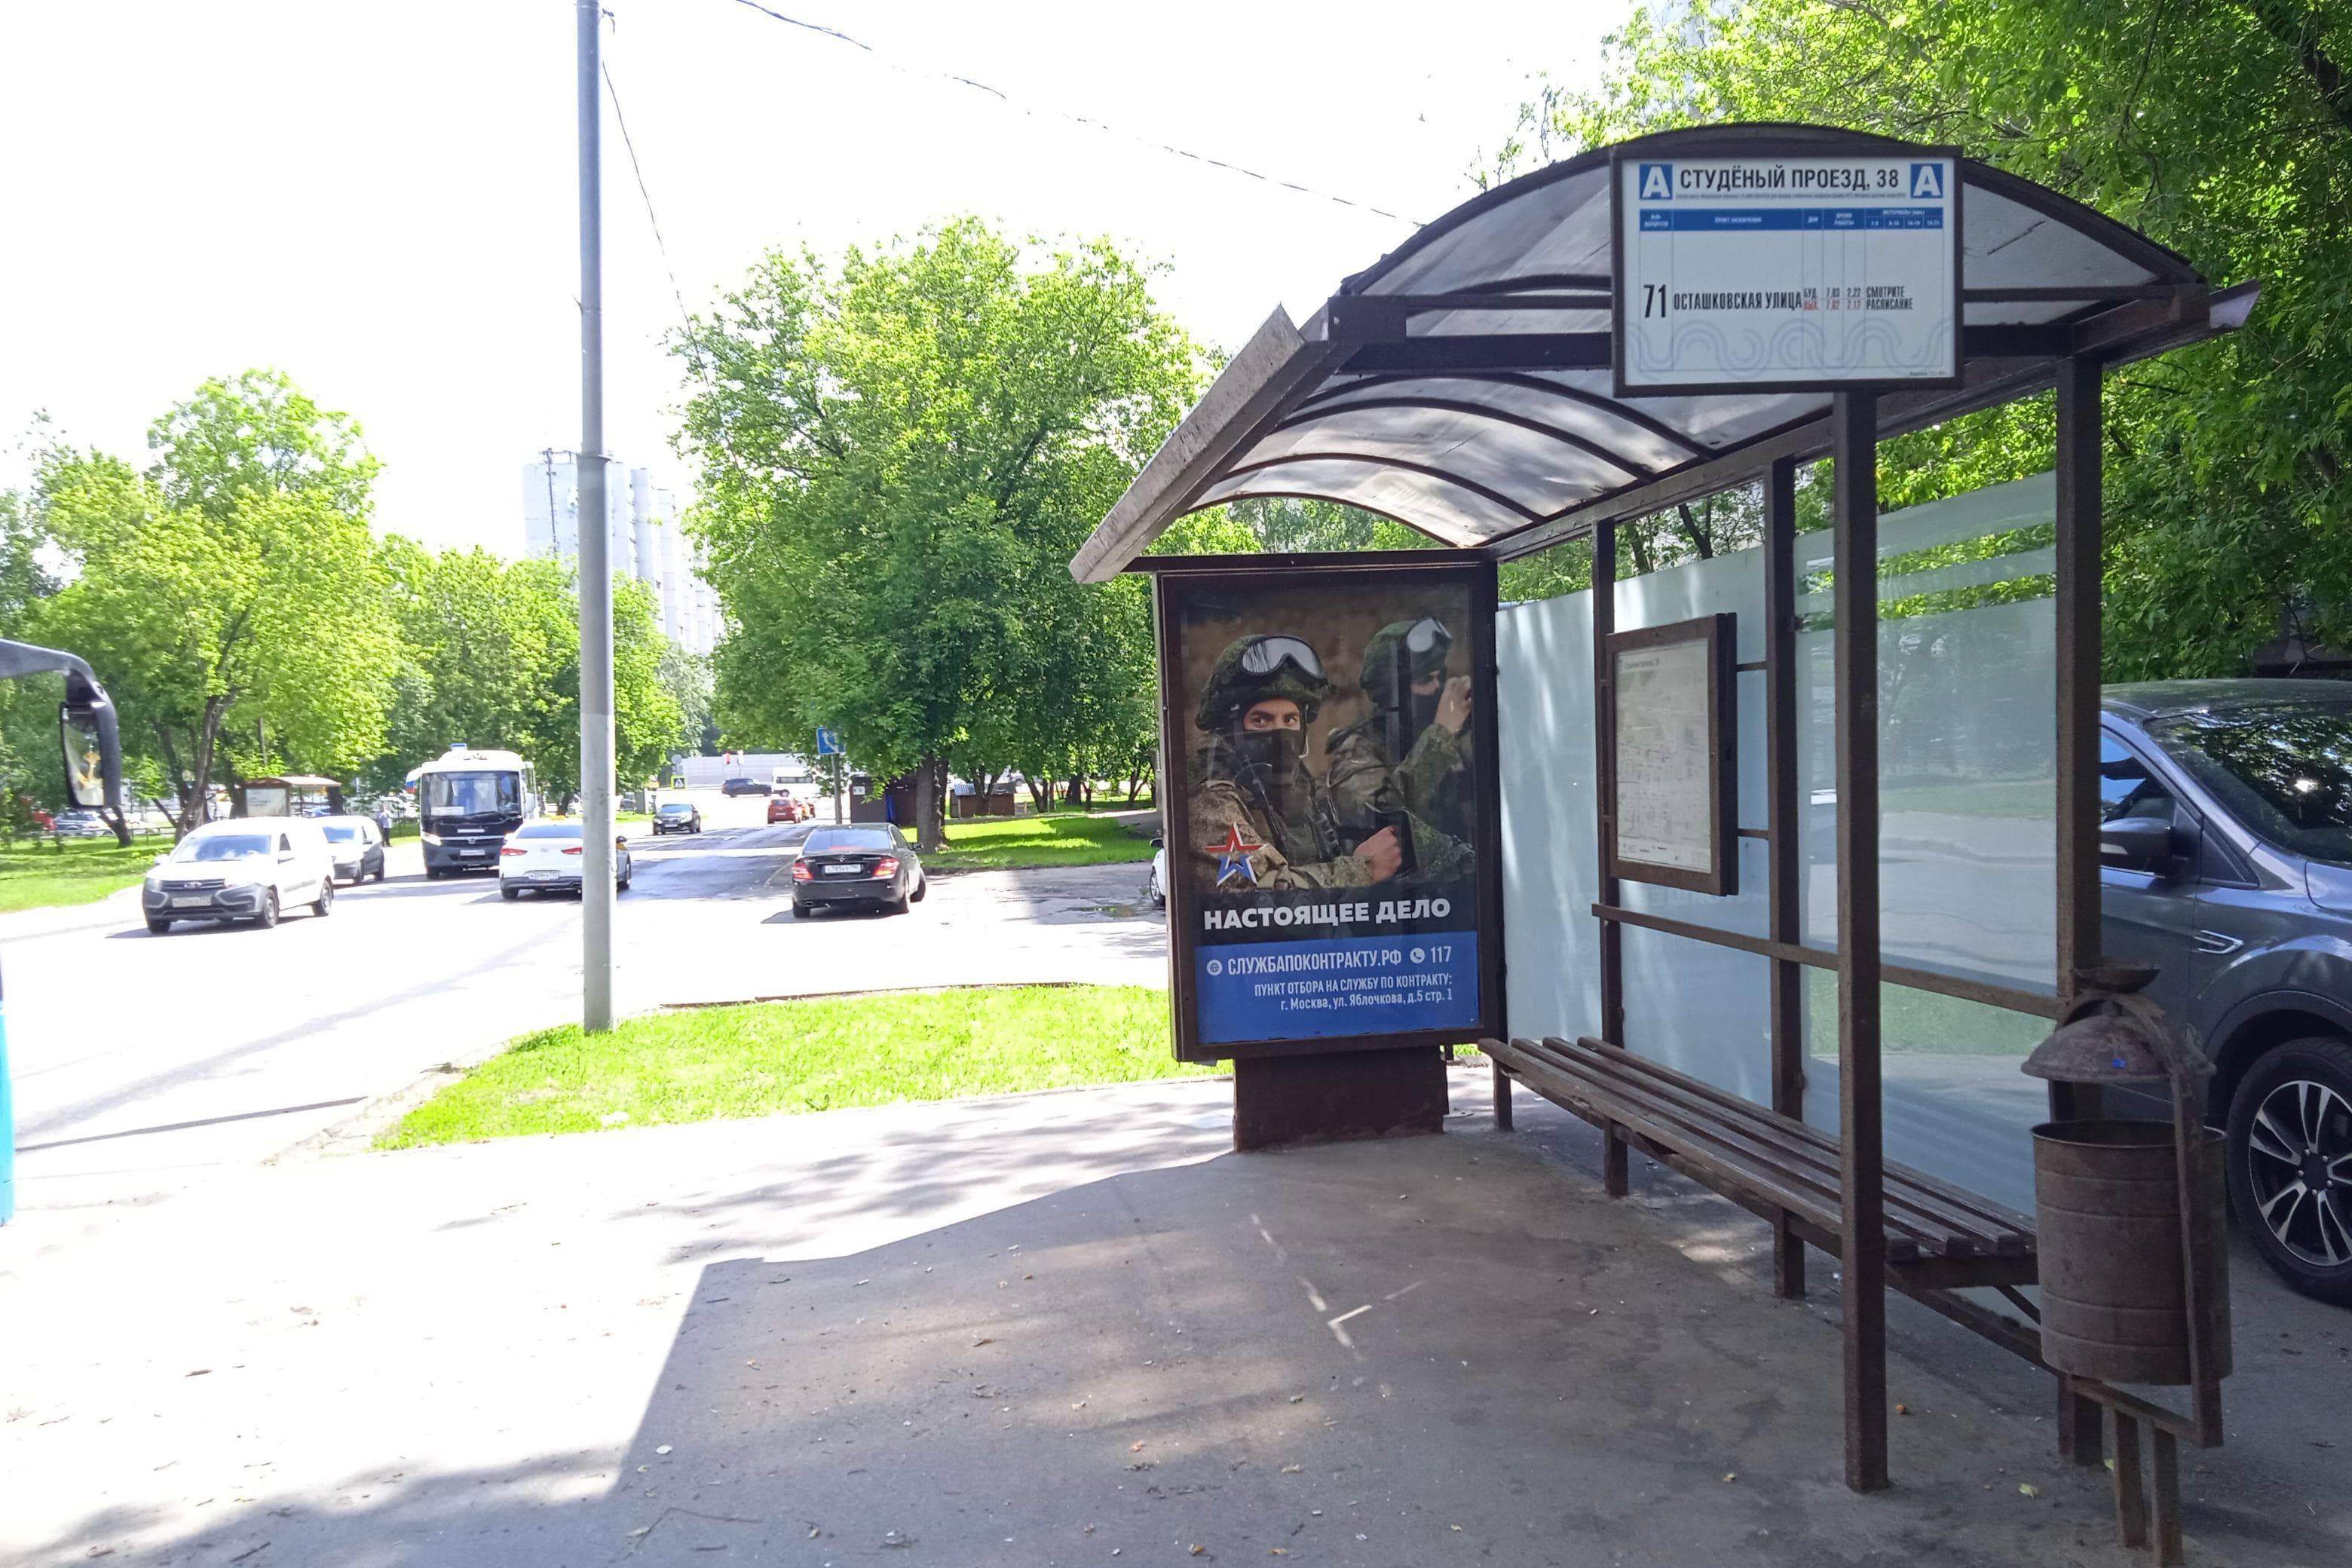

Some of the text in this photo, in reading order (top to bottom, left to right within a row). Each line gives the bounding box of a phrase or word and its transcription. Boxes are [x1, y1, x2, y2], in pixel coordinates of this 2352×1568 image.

[1680, 164, 1786, 192] СТУДЁНЫЙ
[1791, 168, 1871, 191] ПРОЕЗД,
[1876, 169, 1899, 188] 38
[1643, 284, 1802, 318] 71 ОСТАШКОВСКАЯ УЛИЦА
[1867, 286, 1906, 299] СМОТРИТЕ
[1867, 297, 1913, 310] РАСПИСАНИЕ
[1204, 898, 1451, 930] НАСТОЯЩЕЕ ДЕЛО
[1227, 946, 1452, 975] СЛУЖБАПОКОНТРАКТУ.РФ 117
[1254, 972, 1453, 997] ПУНКТ ОТБОРА НА СЛУЖБУ ПО КОНТРАКТУ:
[1281, 988, 1453, 1010] г. Москва, ул. Яблочкова, д.5 стр. 1
